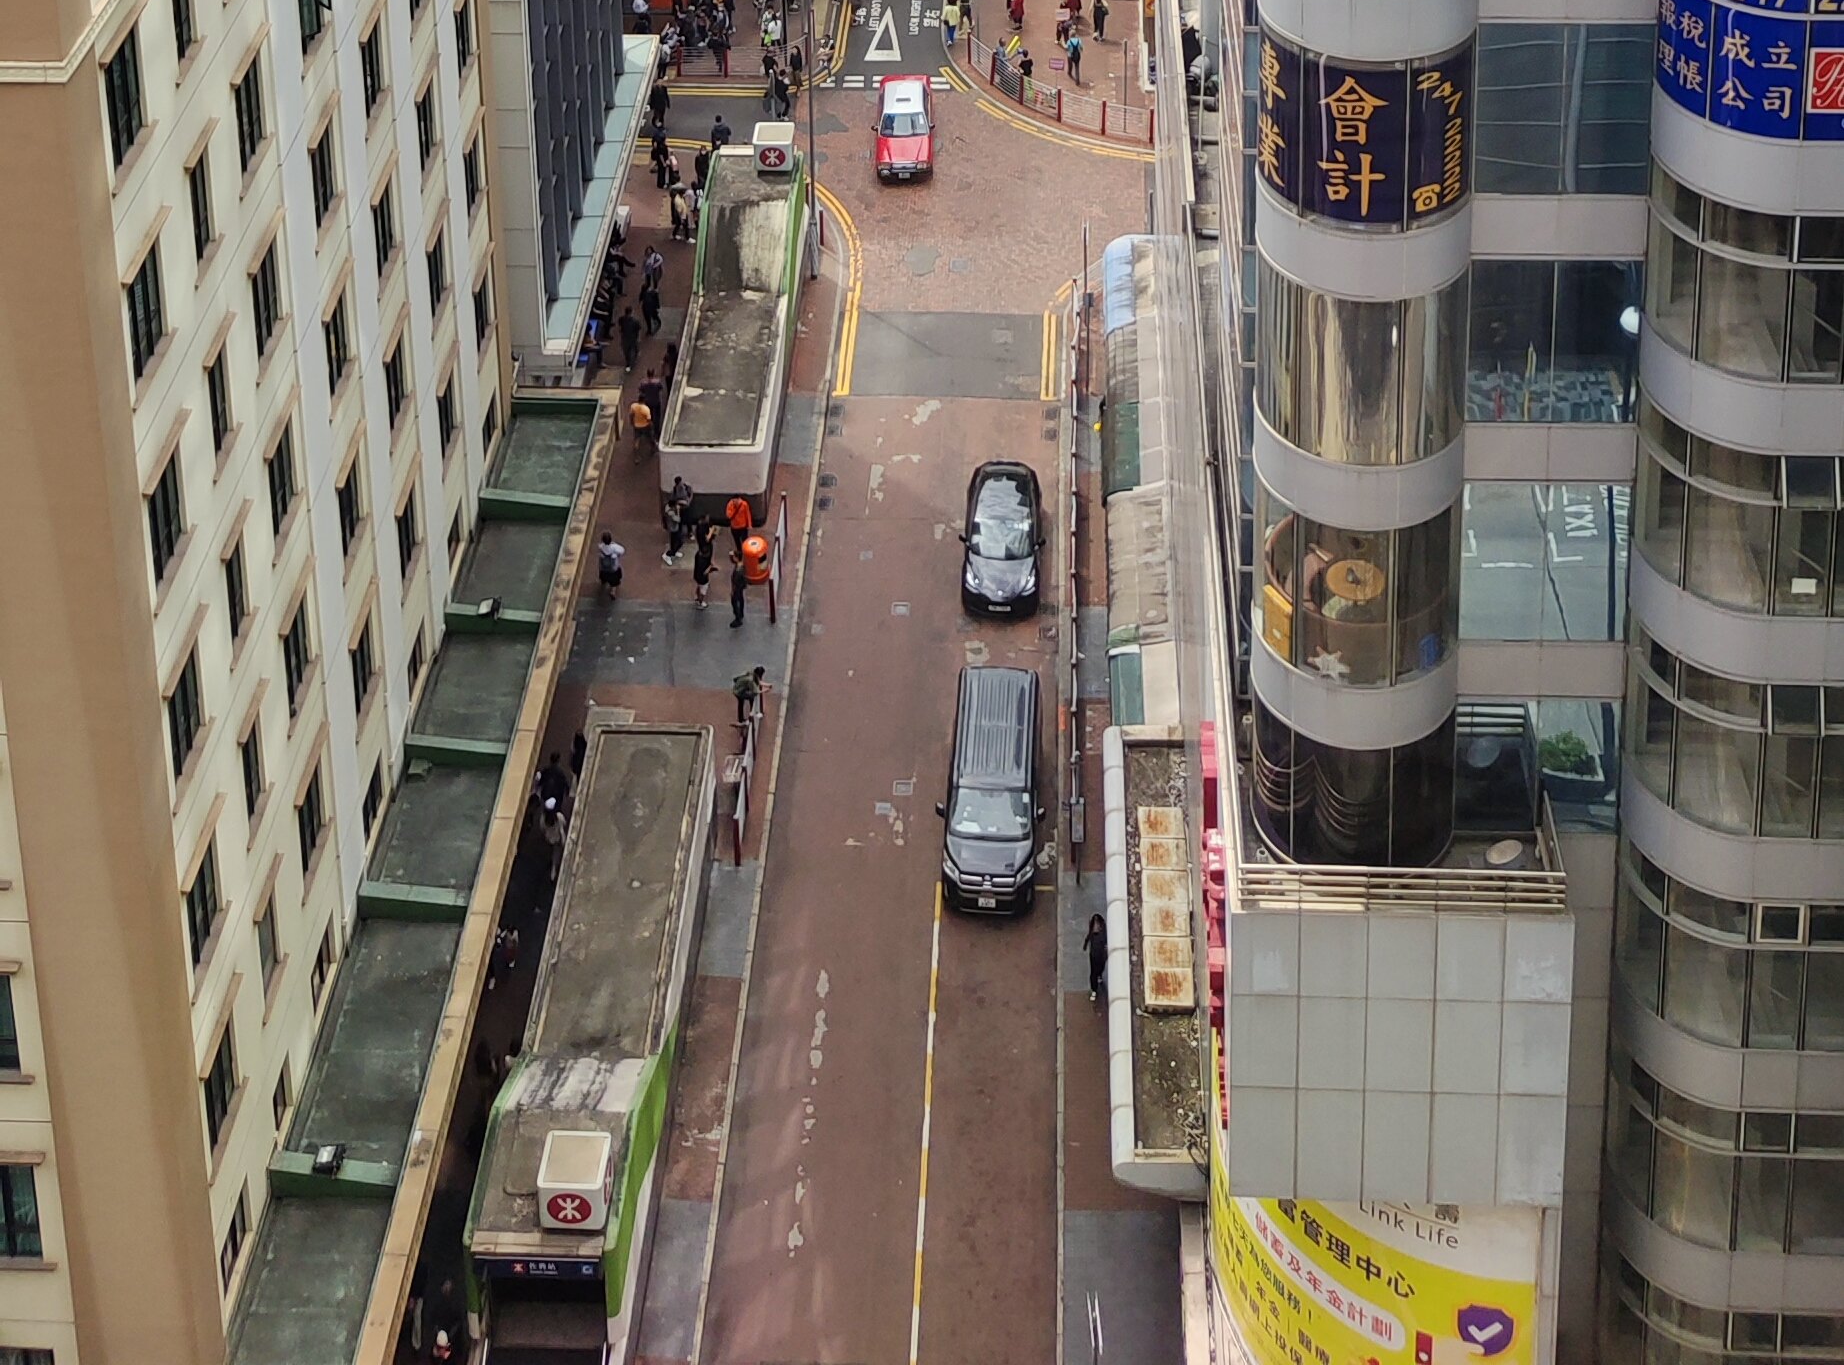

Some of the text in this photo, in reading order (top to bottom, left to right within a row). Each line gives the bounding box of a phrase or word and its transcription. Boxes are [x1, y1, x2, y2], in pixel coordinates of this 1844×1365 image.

[1657, 38, 1704, 95] 理帳
[1718, 29, 1797, 70] 成立
[1716, 77, 1793, 120] 公司
[1317, 75, 1390, 218] 會計
[1359, 1199, 1405, 1232] Link
[1415, 1220, 1459, 1249] Life
